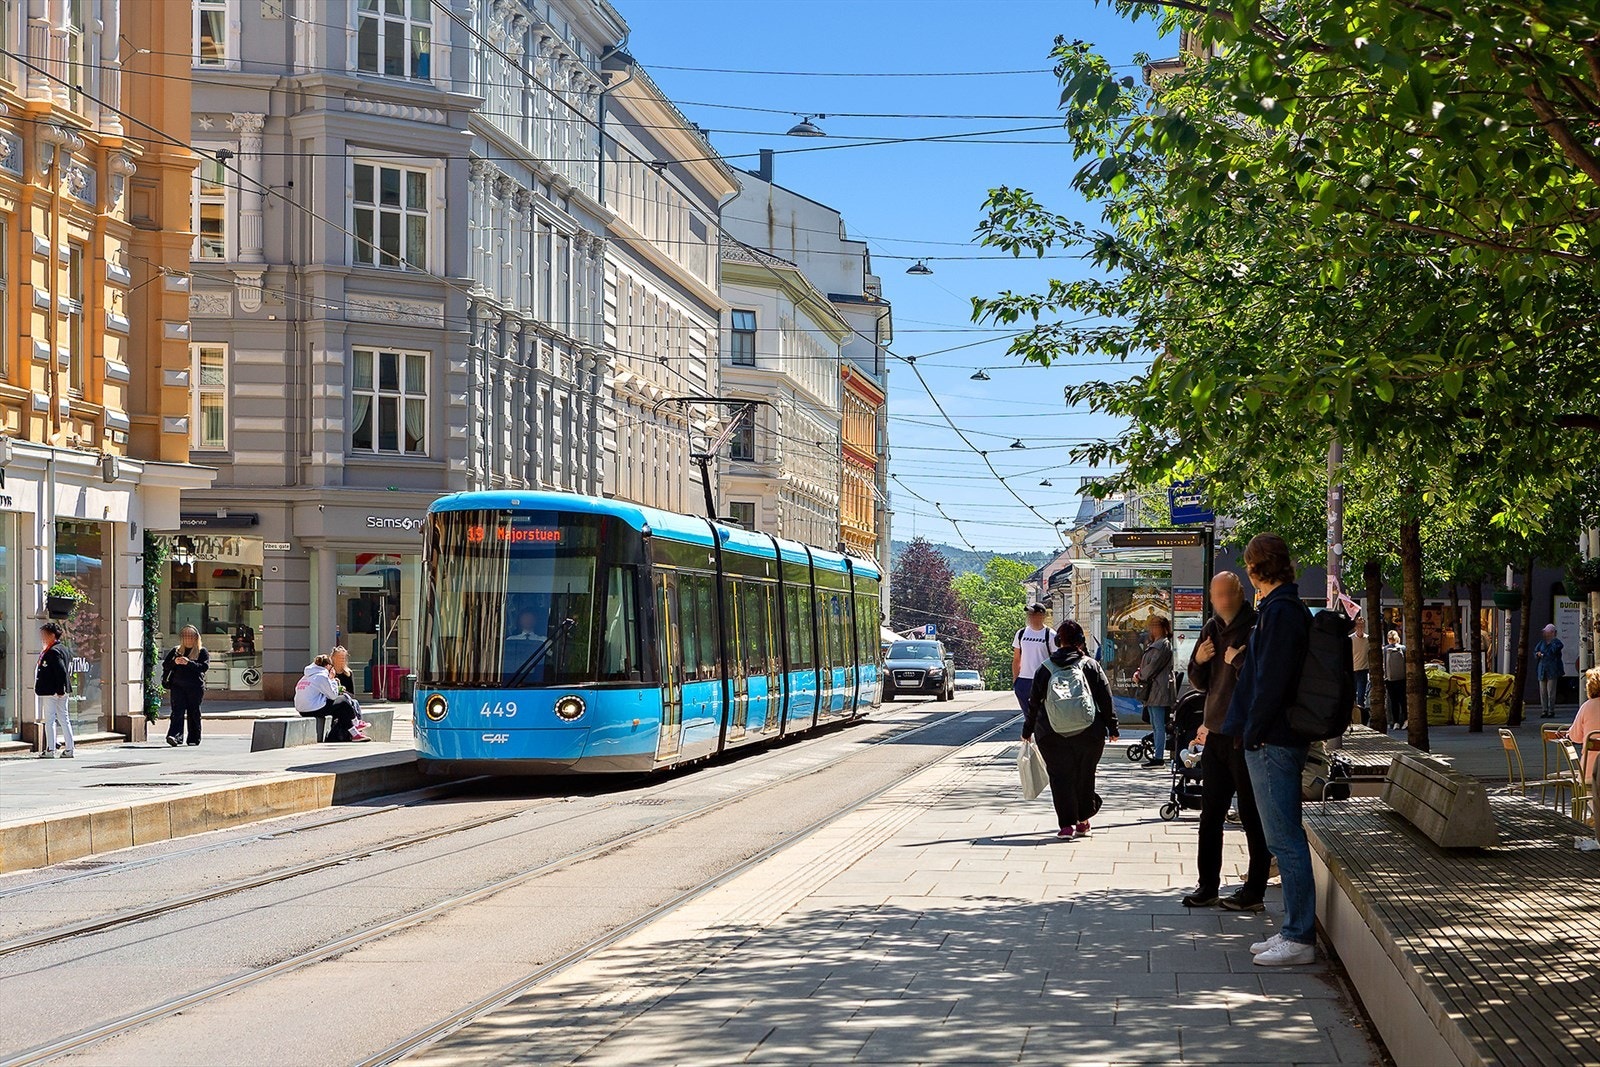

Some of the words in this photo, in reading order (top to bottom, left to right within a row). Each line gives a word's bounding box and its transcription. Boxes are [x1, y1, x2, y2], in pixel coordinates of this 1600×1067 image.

[498, 527, 560, 543] Majorstuen
[928, 626, 934, 634] P
[480, 702, 517, 718] 449
[482, 734, 510, 744] CAF
